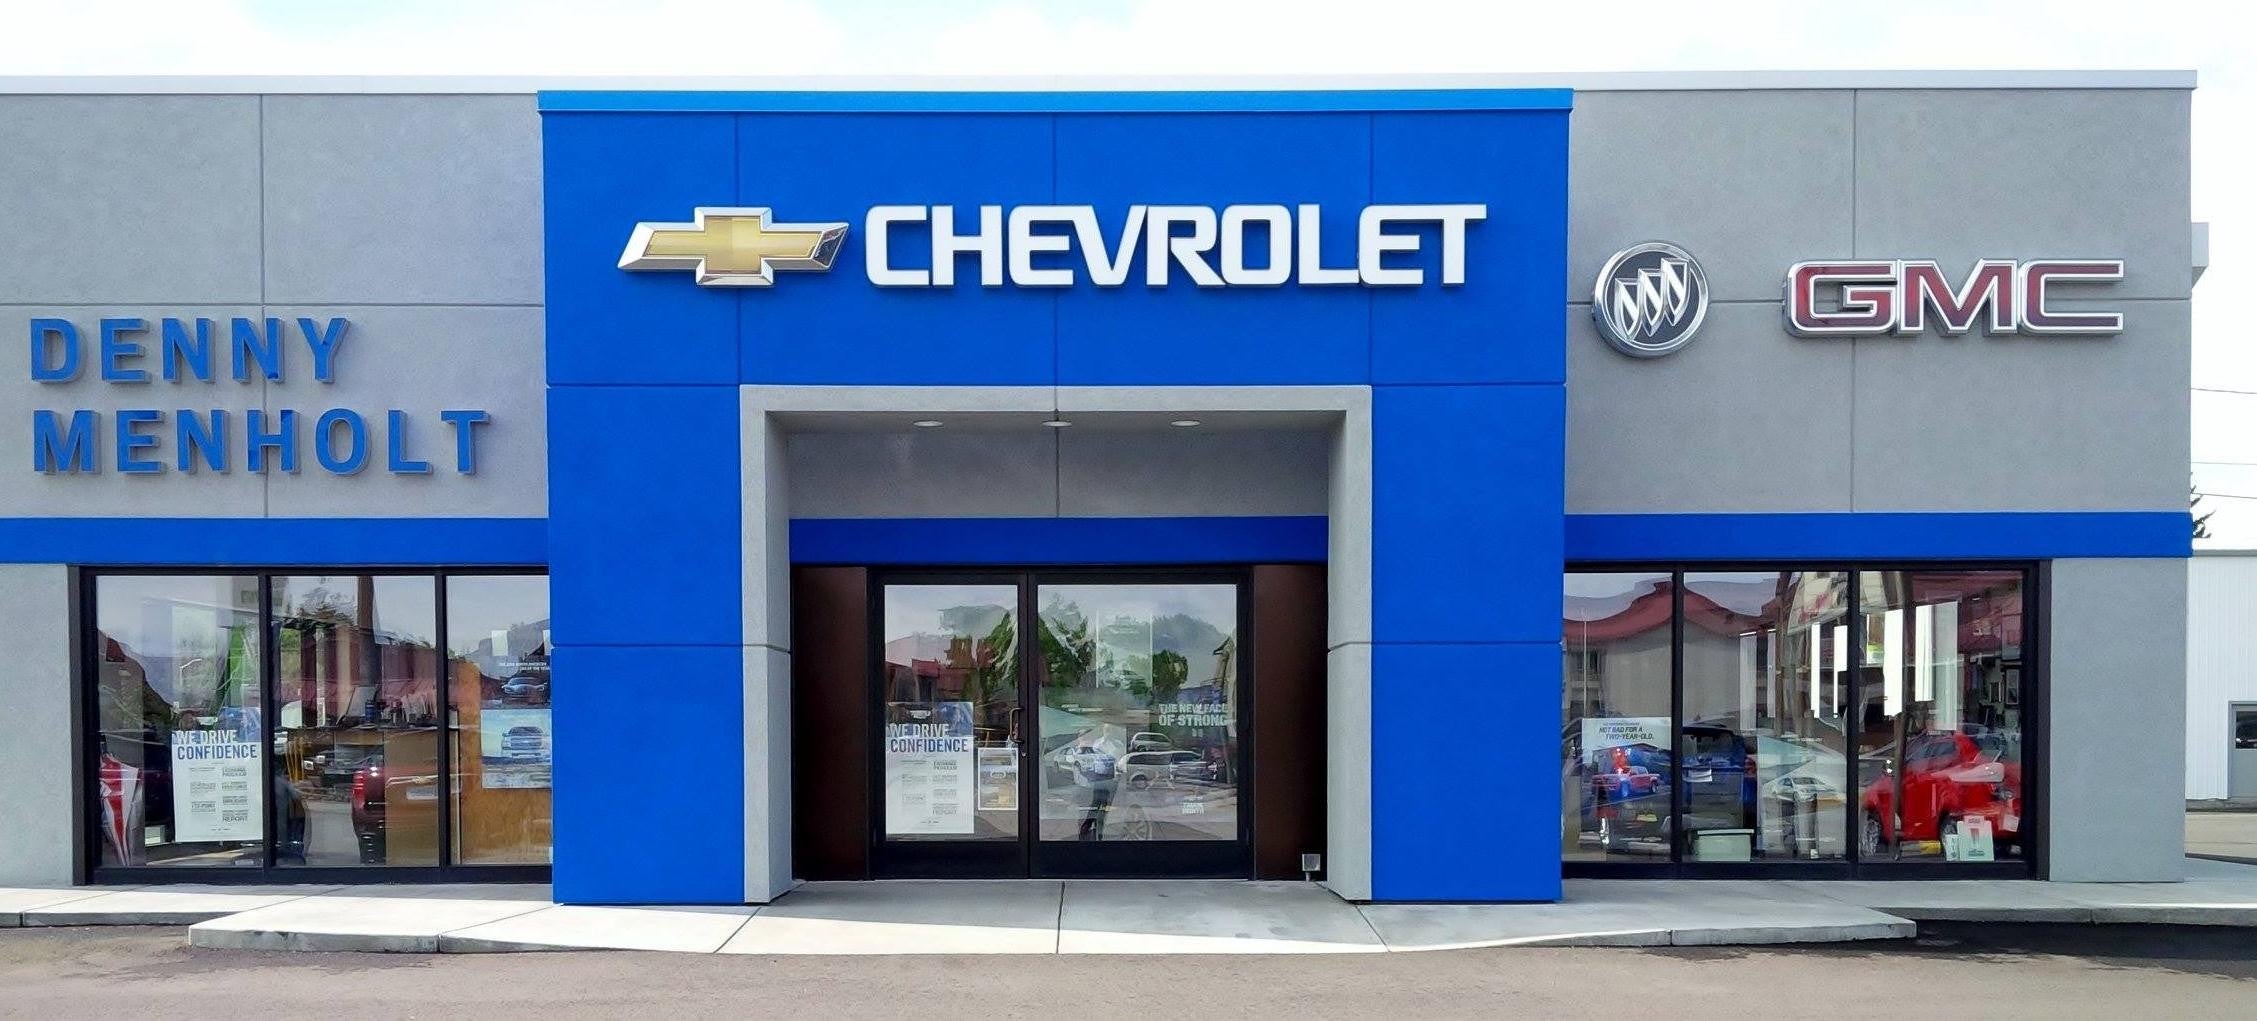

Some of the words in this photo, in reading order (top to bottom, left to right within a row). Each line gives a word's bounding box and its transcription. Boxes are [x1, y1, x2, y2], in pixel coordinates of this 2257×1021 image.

[865, 203, 1487, 286] CHEVROLET
[1785, 258, 2125, 338] GMC
[30, 317, 350, 384] DENNY
[33, 408, 491, 475] MENHOLT
[1158, 703, 1178, 713] THE
[1158, 714, 1175, 726] OF
[1177, 714, 1227, 726] STRONG
[176, 730, 197, 744] WE
[201, 730, 238, 744] DRIVE
[889, 723, 910, 737] WE
[913, 723, 949, 737] DRIVE
[177, 745, 258, 760] CONFIDENCE
[890, 738, 968, 753] CONFIDENCE
